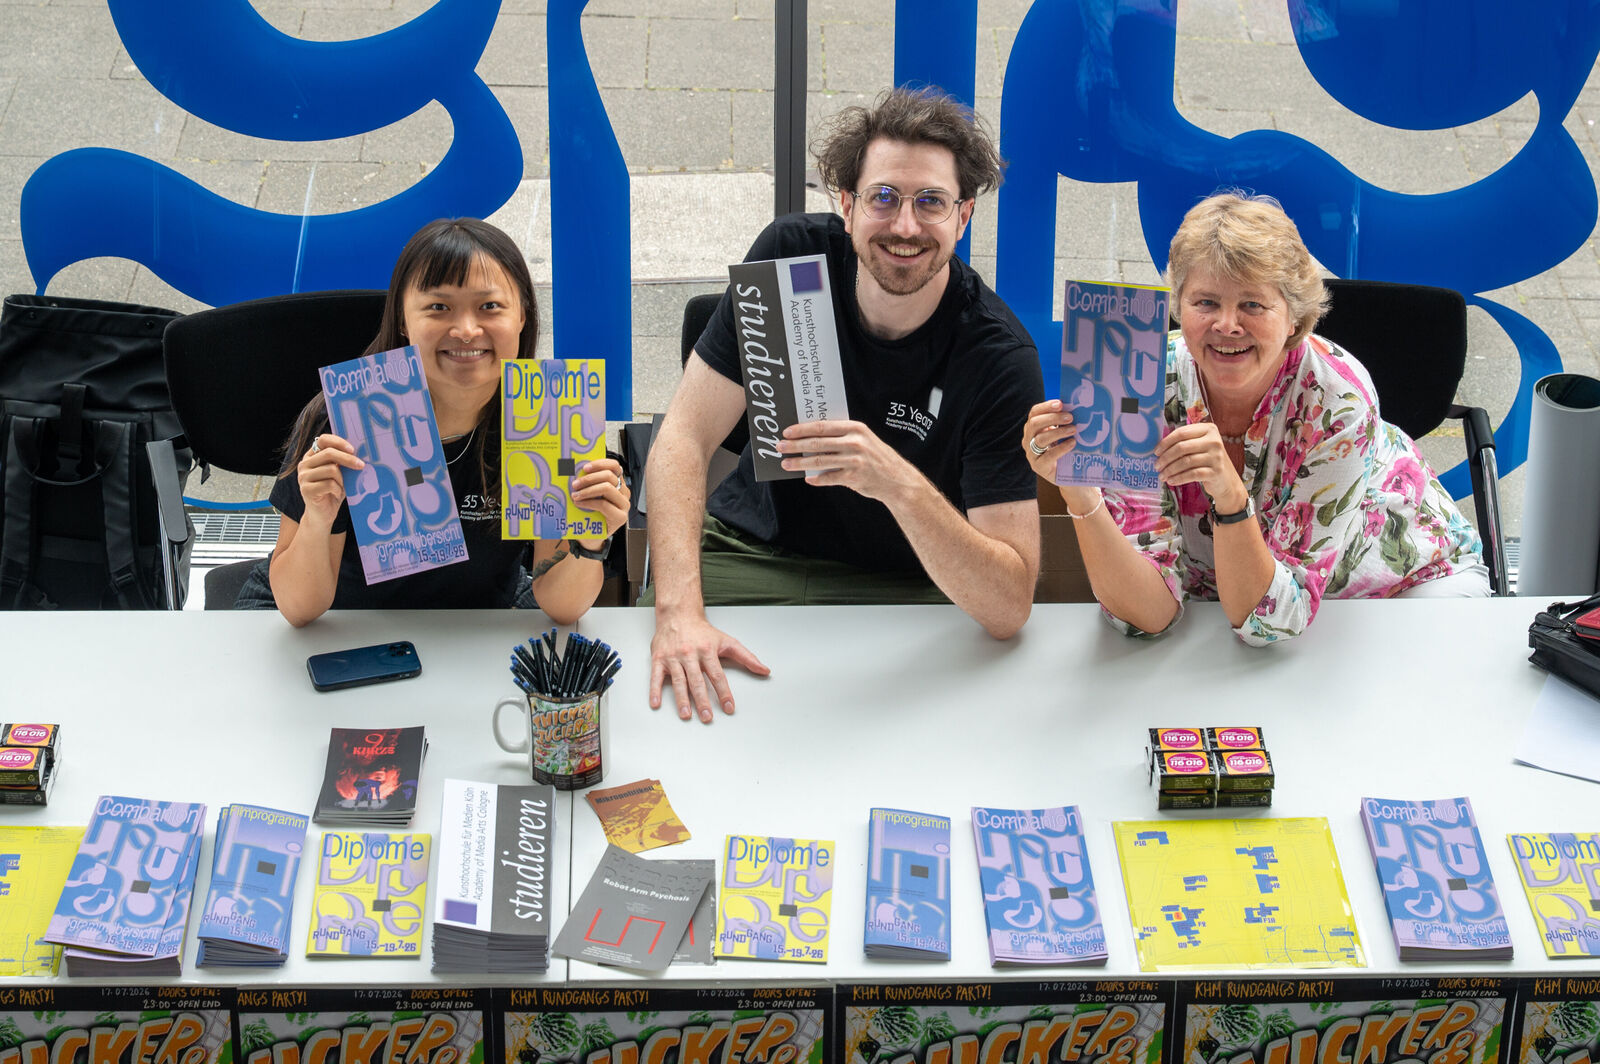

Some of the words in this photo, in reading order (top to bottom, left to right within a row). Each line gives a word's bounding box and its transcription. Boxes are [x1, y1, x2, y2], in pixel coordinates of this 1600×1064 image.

[1066, 283, 1167, 320] Companion
[790, 300, 803, 347] Academy
[797, 350, 806, 360] of
[803, 298, 822, 383] Kunsthochschule
[815, 384, 824, 399] für
[323, 355, 421, 397] Companion
[736, 283, 785, 459] studieren
[800, 364, 810, 395] Media
[505, 361, 601, 410] Diplome
[804, 398, 814, 419] Arts
[887, 401, 907, 417] 35
[461, 494, 478, 508] 35
[505, 498, 555, 521] RUNDGANG
[96, 797, 199, 824] Companion
[229, 804, 306, 829] Filmprogramm
[872, 809, 949, 830] Filmprogramm
[1365, 799, 1471, 827] Companion
[975, 808, 1078, 834] Companion
[322, 833, 424, 865] Diplome
[728, 836, 830, 868] Diplome
[501, 799, 548, 922] studieren
[603, 877, 629, 891] Robot
[629, 887, 649, 896] Arm
[650, 890, 690, 902] Psychosis
[202, 911, 256, 929] RUNDGANG
[867, 917, 920, 933] RUNDGANG
[312, 925, 366, 940] RUNDGANG
[719, 928, 773, 943] RUNDGANG
[1545, 927, 1599, 942] RUNDGANG
[157, 987, 187, 997] DOORS
[853, 985, 880, 1000] KHM
[885, 985, 952, 1000] RUNDGANGS
[955, 984, 992, 1000] PARTY!
[1095, 981, 1125, 992] DOORS
[1195, 982, 1222, 998] KHM
[1227, 981, 1294, 998] RUNDGANGS
[1298, 980, 1335, 998] PARTY!
[1437, 978, 1467, 988] DOORS
[1534, 978, 1561, 996] KHM
[19, 988, 55, 1006] PARTY!
[271, 991, 309, 1008] PARTY!
[411, 989, 440, 999] DOORS
[510, 989, 538, 1006] KHM
[542, 989, 610, 1006] RUNDGANGS
[613, 989, 649, 1006] PARTY!
[753, 988, 782, 998] DOORS
